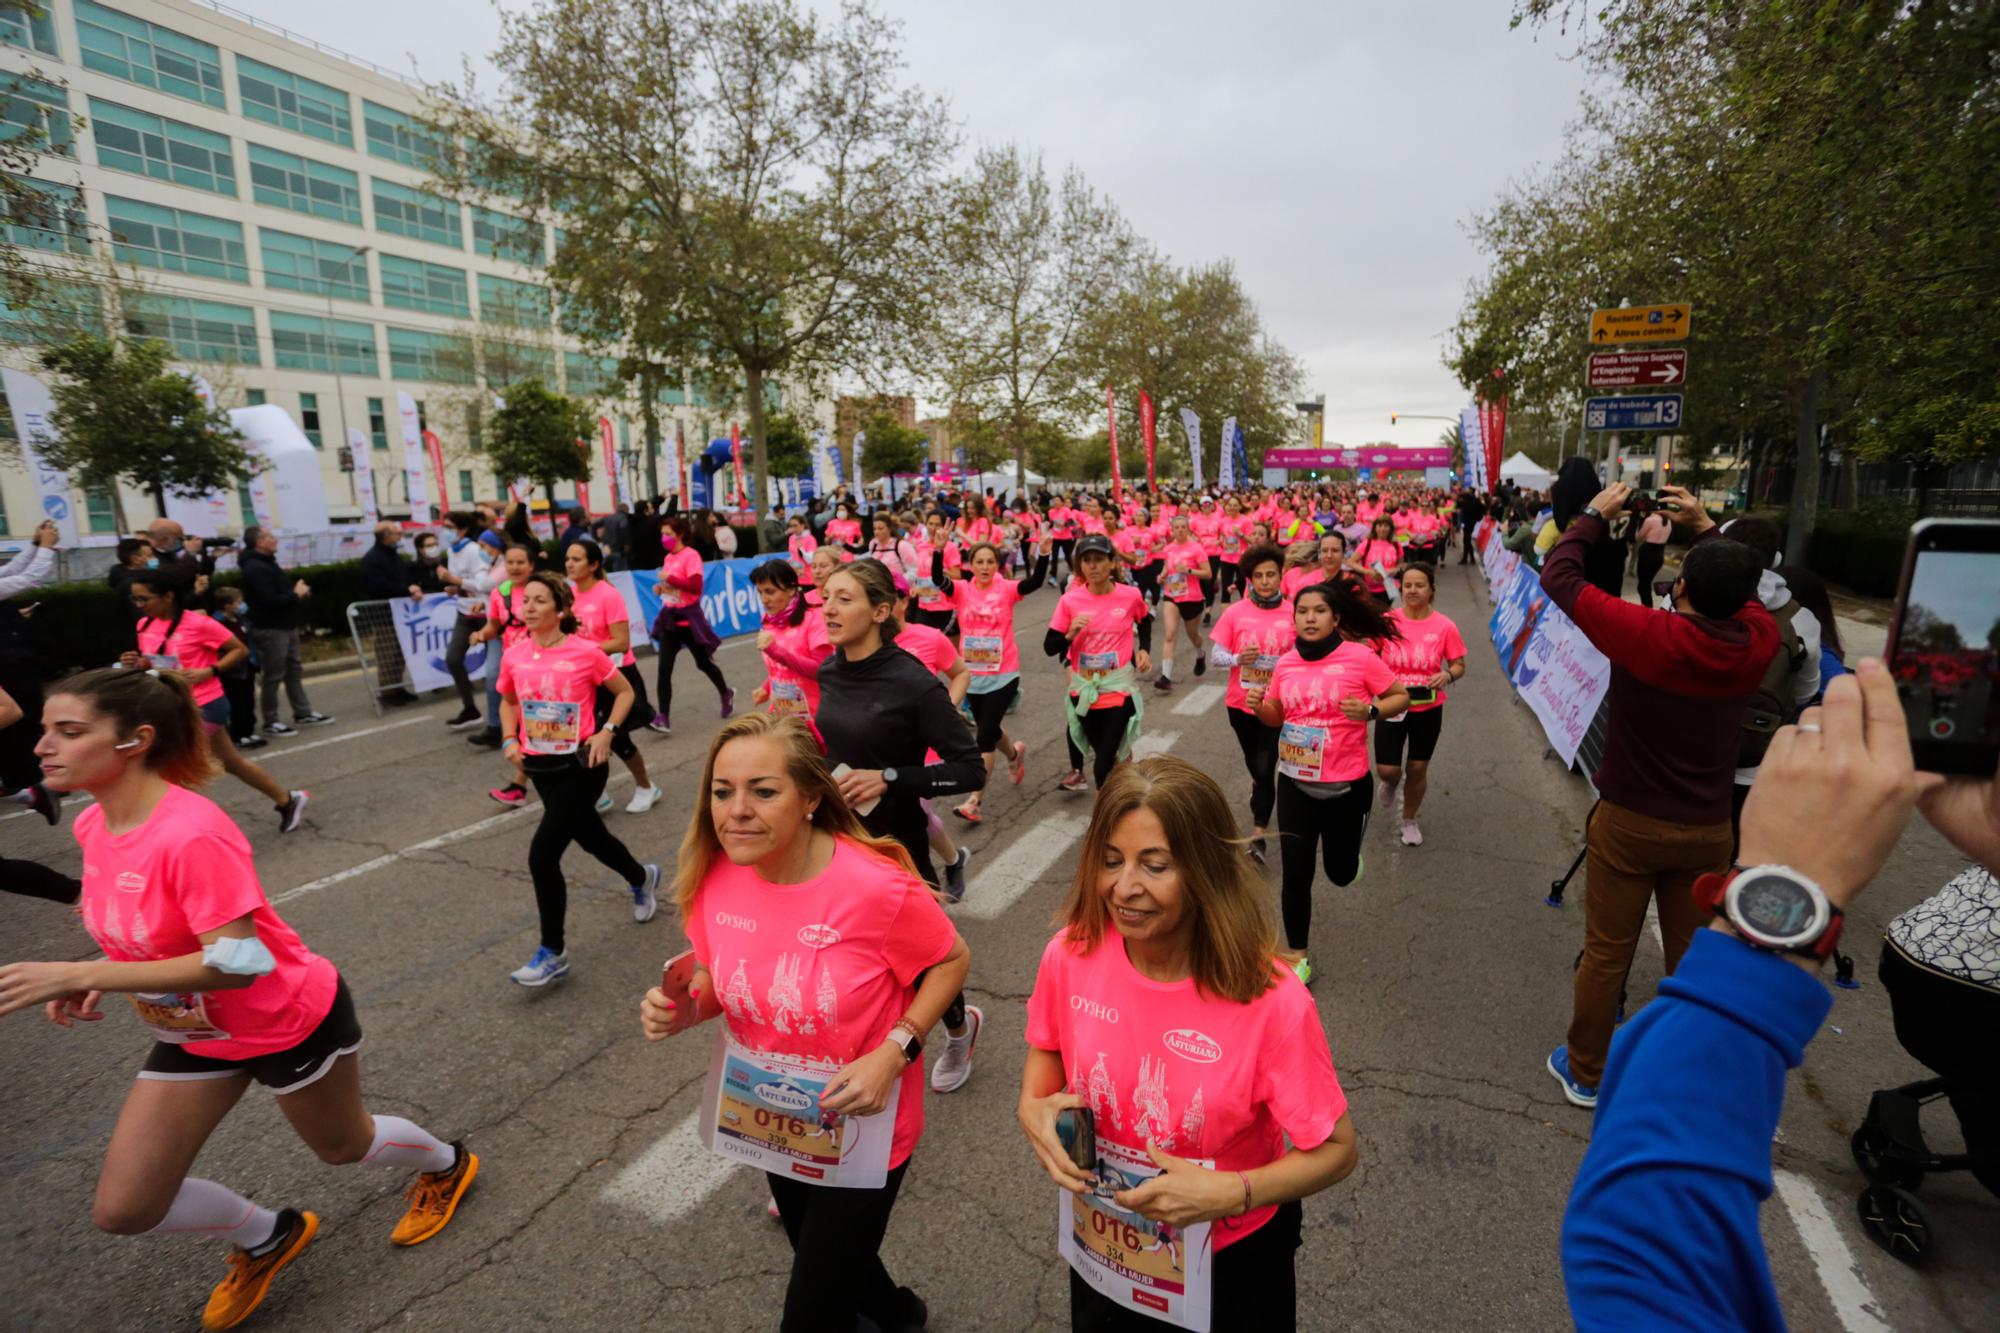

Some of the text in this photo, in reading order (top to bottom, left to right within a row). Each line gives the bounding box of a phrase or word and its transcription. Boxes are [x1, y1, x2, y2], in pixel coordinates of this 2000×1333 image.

[1614, 328, 1676, 337] Altres centres
[1650, 353, 1683, 363] Superior
[1608, 401, 1618, 409] de
[1653, 400, 1678, 423] 13
[1286, 744, 1304, 756] 016
[716, 912, 757, 933] OYSHO
[1070, 995, 1119, 1024] OYSHO
[1167, 1034, 1217, 1059] ASTURIANA
[758, 1086, 808, 1108] ASTURIANA
[754, 1107, 806, 1136] 016
[767, 1132, 788, 1145] 339
[724, 1141, 762, 1160] OYSHO
[771, 1143, 779, 1152] DE
[780, 1145, 789, 1154] LA
[790, 1149, 814, 1161] MUJER
[1091, 1209, 1140, 1251] 016
[1106, 1244, 1124, 1263] 334
[1076, 1253, 1103, 1283] OYSHO
[1109, 1260, 1118, 1272] DE
[1118, 1265, 1128, 1277] LA
[1128, 1269, 1154, 1286] MUJER
